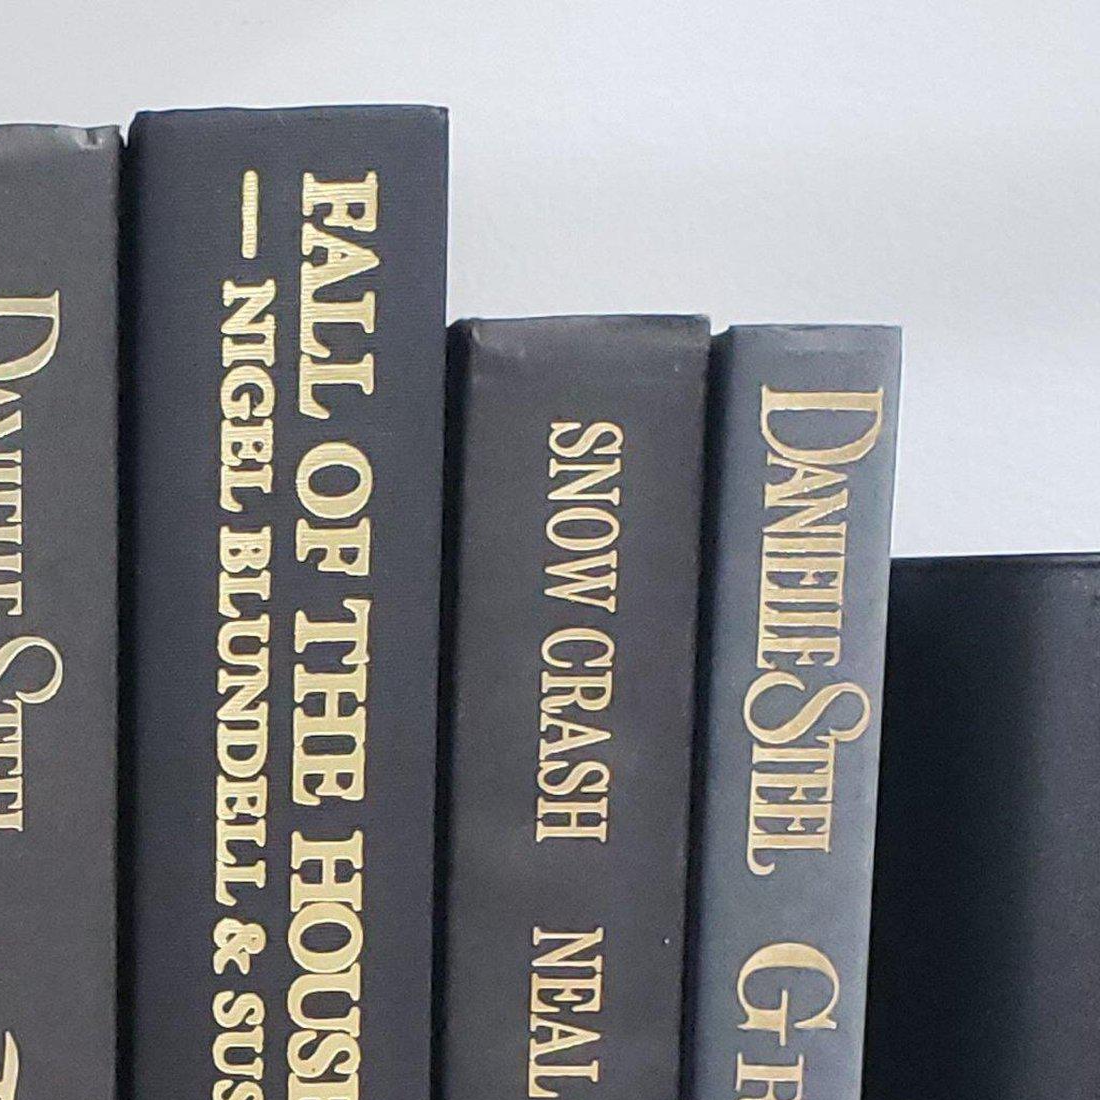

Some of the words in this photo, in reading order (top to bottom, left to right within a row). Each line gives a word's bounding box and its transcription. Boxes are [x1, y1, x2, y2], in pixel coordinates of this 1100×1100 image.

[219, 278, 277, 513] NIGEL
[298, 171, 380, 420] FALL
[295, 442, 373, 577] OF
[544, 421, 624, 613] SNOW
[757, 384, 884, 670] DANIELLE
[215, 525, 272, 907] BLUNDELL
[292, 598, 371, 806] THE
[535, 627, 615, 843] CRASH
[743, 670, 871, 876] STEEL
[213, 917, 266, 975] &
[528, 926, 604, 1098] NEAL
